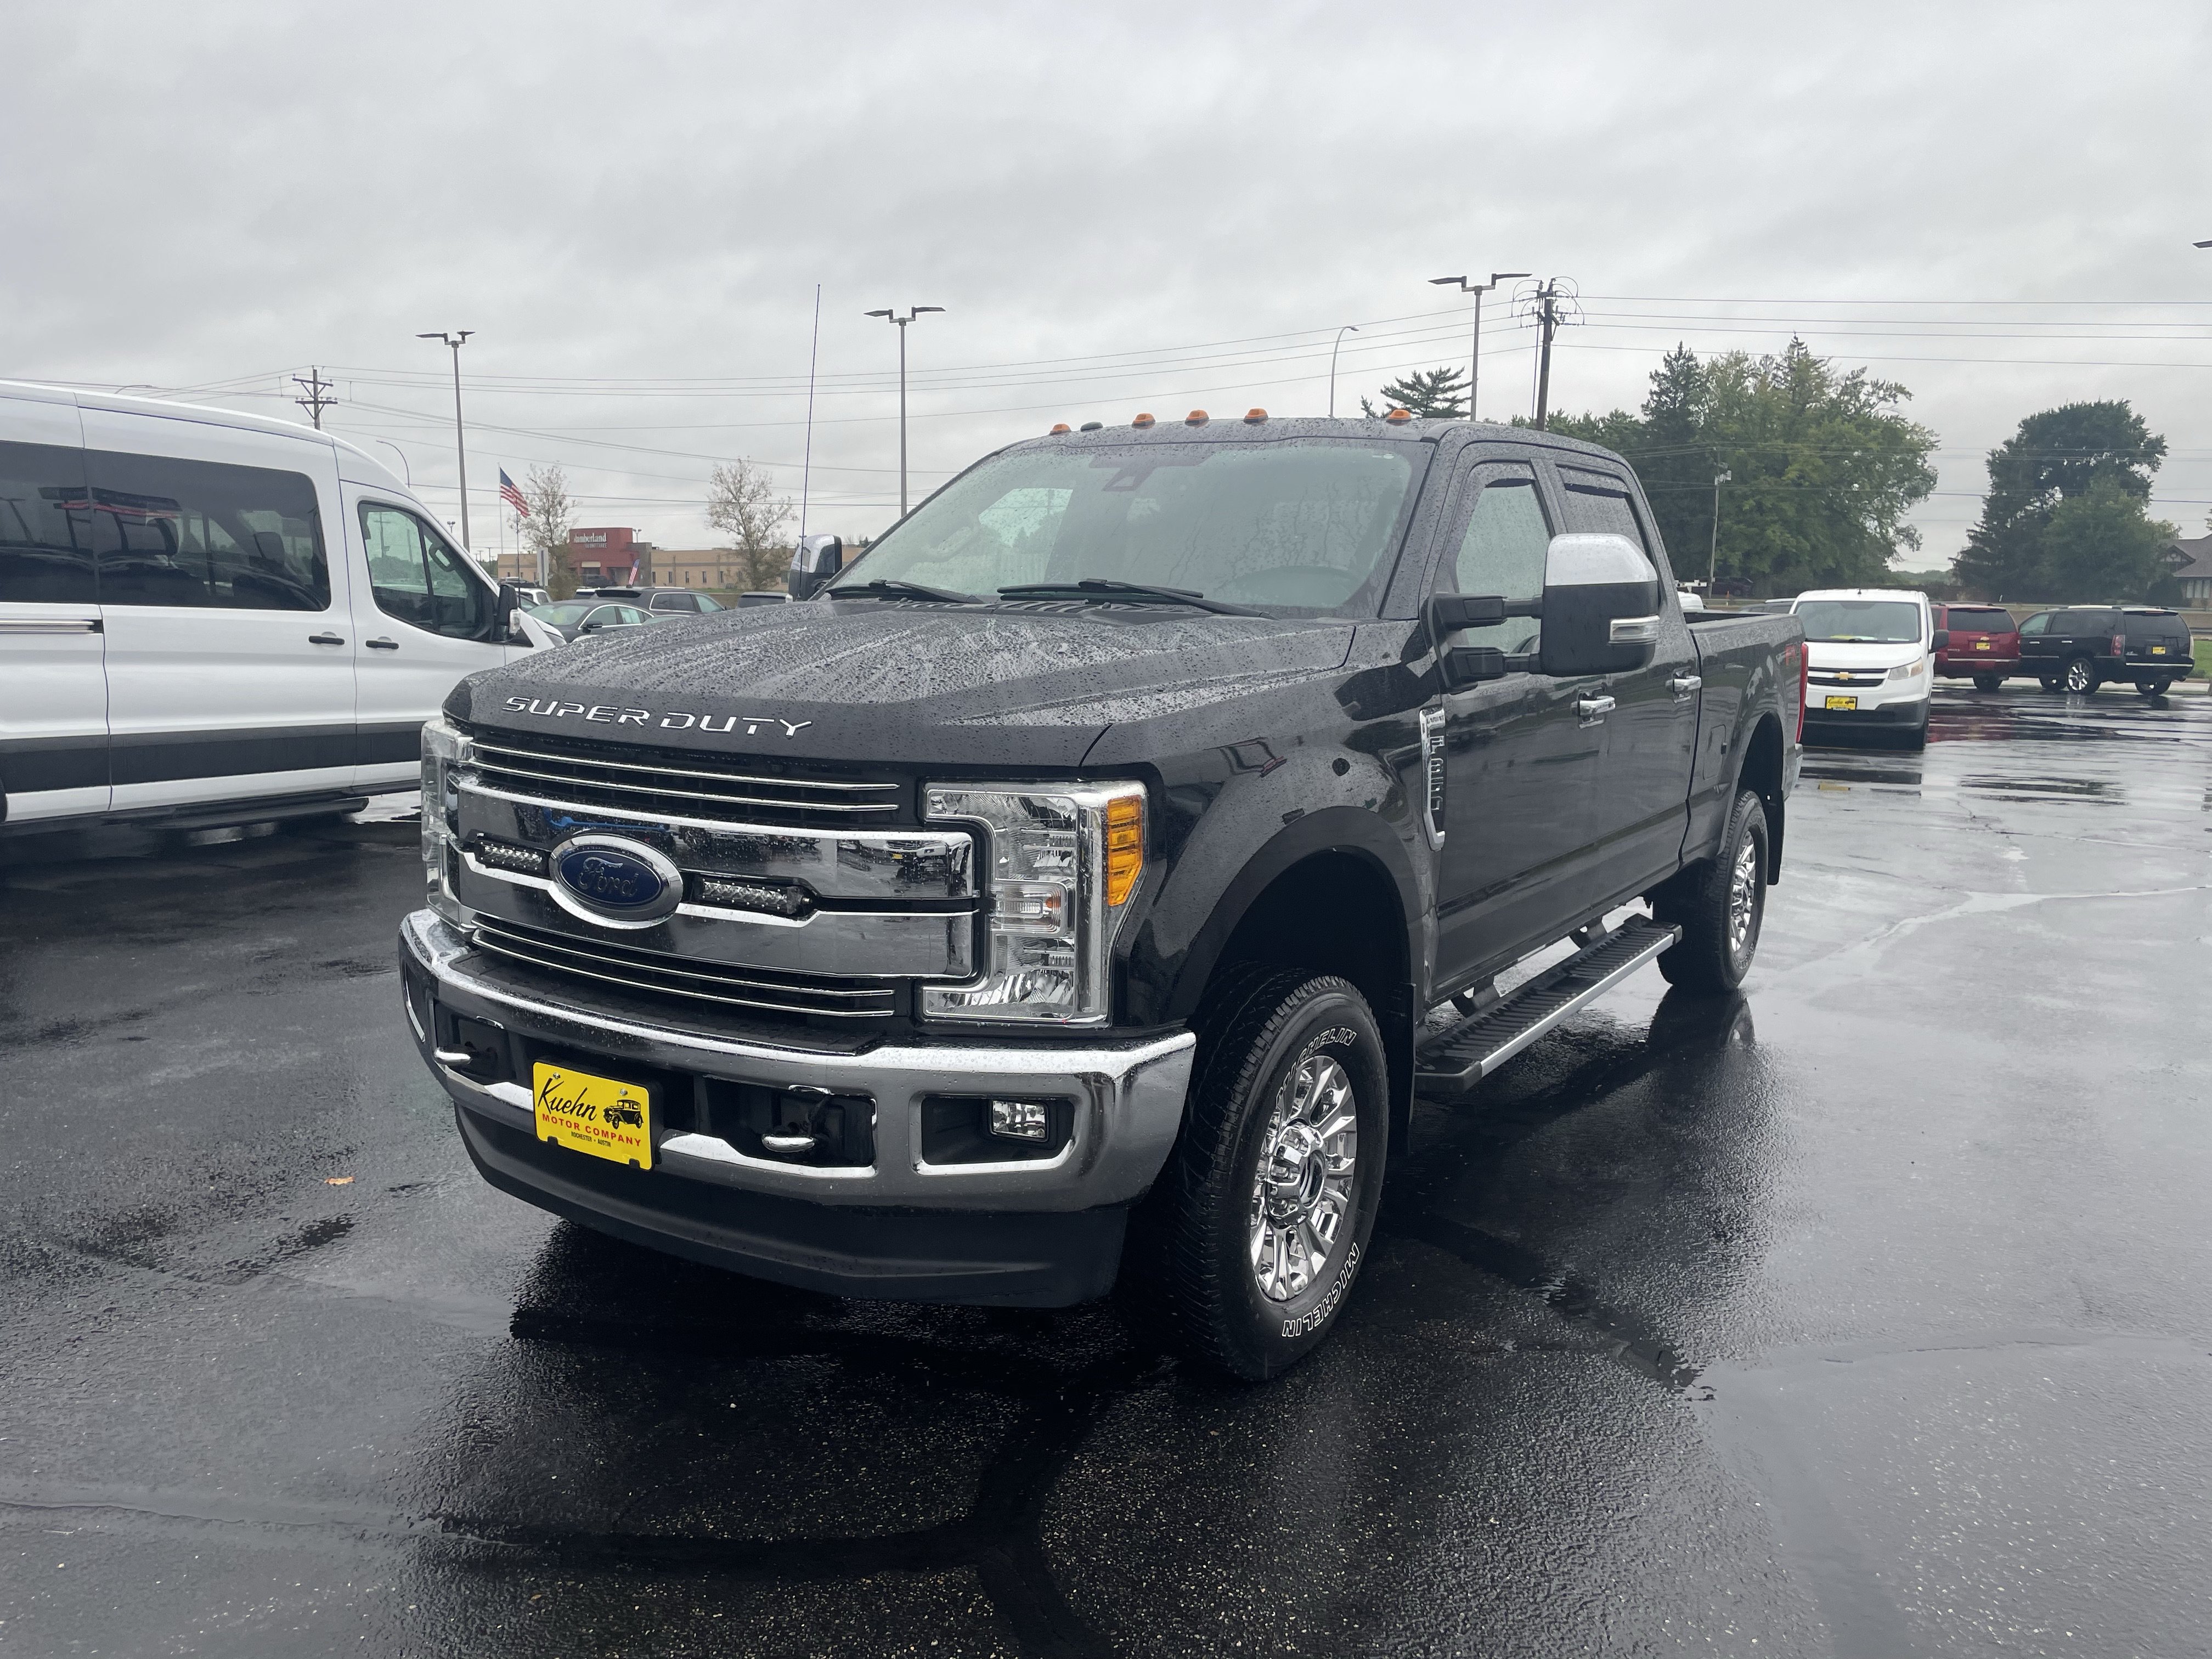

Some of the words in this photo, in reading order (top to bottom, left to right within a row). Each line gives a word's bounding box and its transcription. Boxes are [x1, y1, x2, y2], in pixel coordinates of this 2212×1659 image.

[502, 696, 651, 726] SUPER
[660, 712, 812, 738] DUTY
[578, 856, 640, 898] Ford
[538, 1077, 597, 1121] Kuehn
[542, 1113, 580, 1131] MOTOR
[585, 1125, 641, 1147] COMPANY
[571, 1131, 592, 1142] ROCHESTER
[597, 1138, 611, 1148] AUSTIN
[1282, 1242, 1360, 1337] MICHELIN
